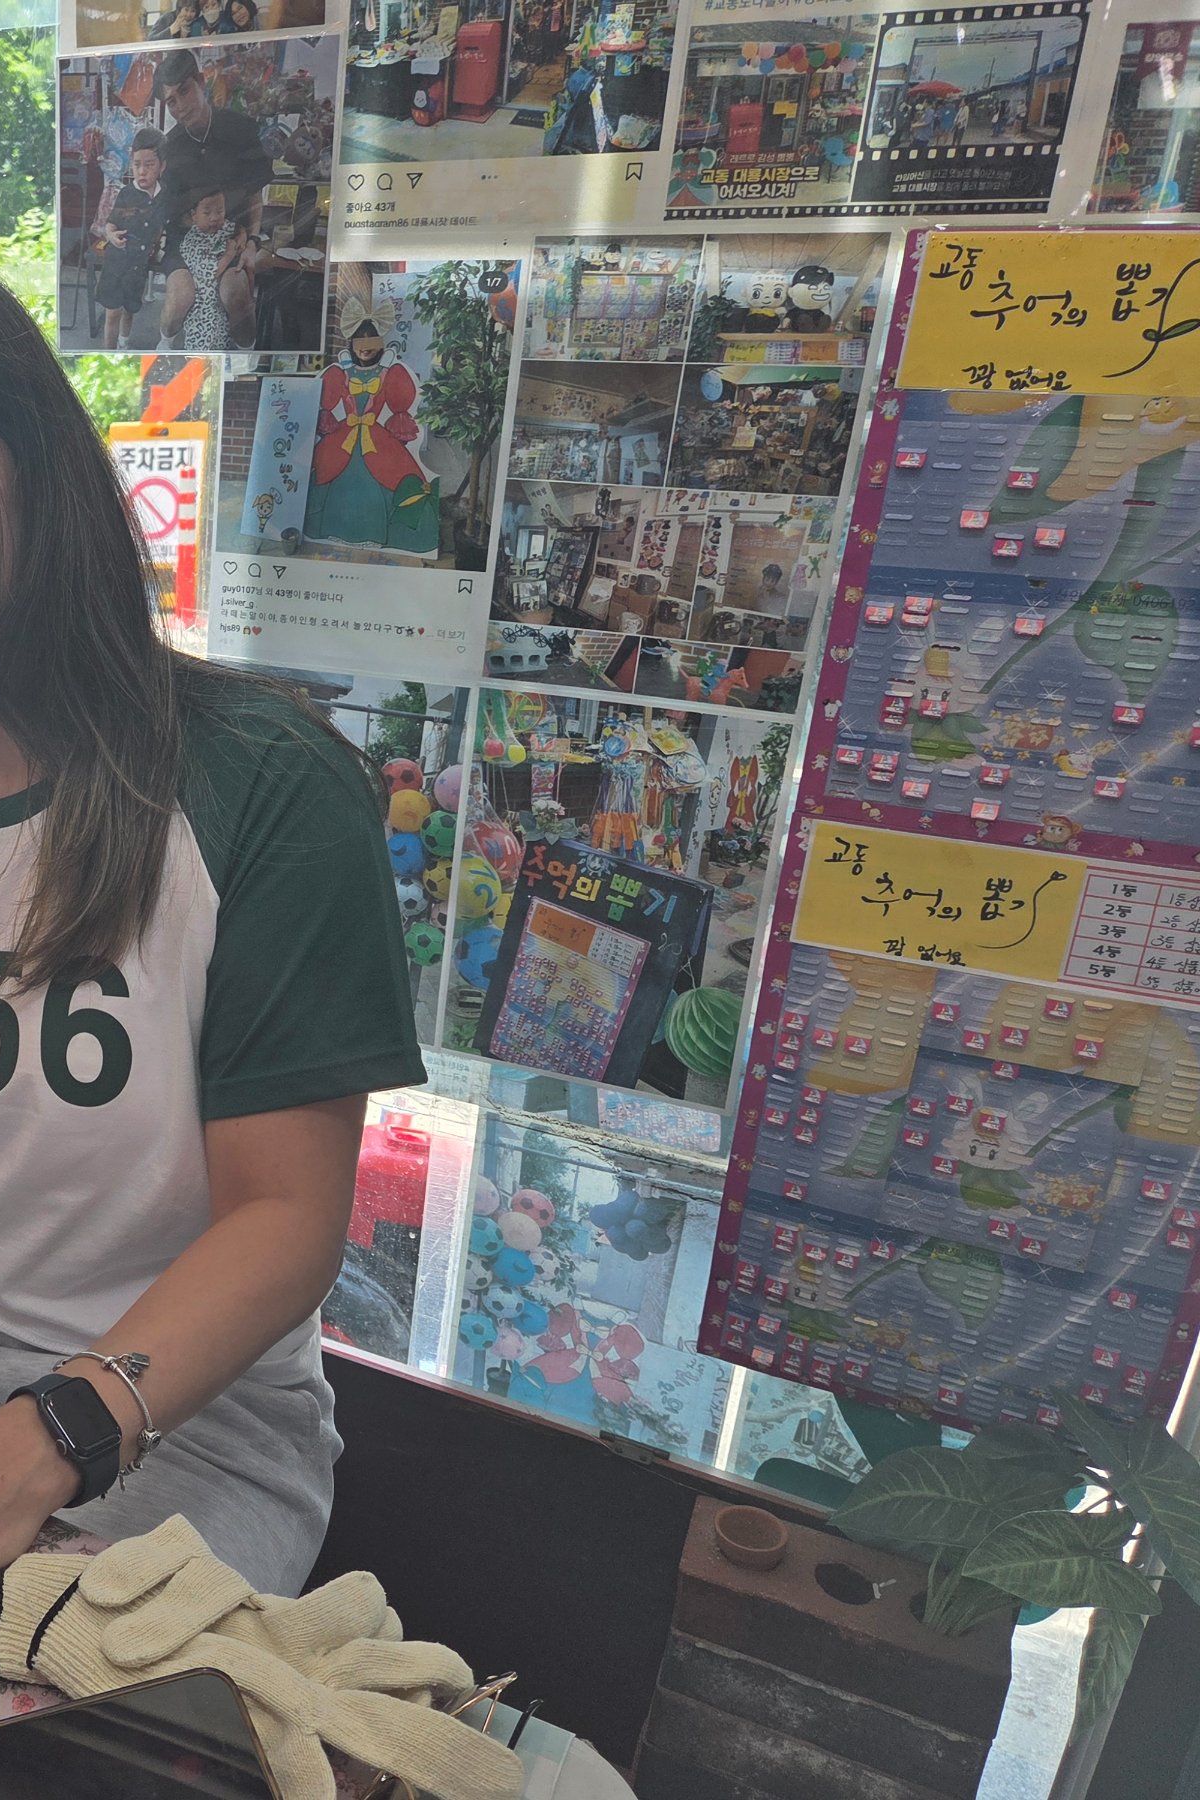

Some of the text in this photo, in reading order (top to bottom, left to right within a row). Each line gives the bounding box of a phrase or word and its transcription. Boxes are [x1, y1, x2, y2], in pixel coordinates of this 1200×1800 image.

[701, 166, 820, 183] 교동 대룡시장으로
[346, 201, 395, 213] 좋아요 43개
[450, 216, 478, 226] 데이트
[486, 278, 501, 287] 1/7
[929, 244, 983, 290] 교동
[970, 270, 1087, 330] 추억의
[1005, 366, 1072, 391] 없어요
[120, 447, 193, 471] 주차금지
[275, 589, 301, 599] 43명이
[303, 591, 344, 602] 좋아합니다
[220, 623, 241, 633] hjs89
[522, 845, 678, 923] 추억의 뽑기
[824, 837, 869, 875] 교동
[861, 872, 962, 921] 추억의
[1112, 884, 1138, 898] 1등
[1169, 893, 1187, 907] 1등
[1103, 904, 1132, 918] 2등
[1160, 915, 1181, 928] 2등
[1098, 925, 1127, 939] 3등
[1151, 935, 1175, 949] 3등
[917, 944, 967, 967] 없어요
[1093, 945, 1121, 958] 4등
[1146, 957, 1167, 970] 4등
[1088, 964, 1116, 978] 5등
[1141, 976, 1161, 989] 5등
